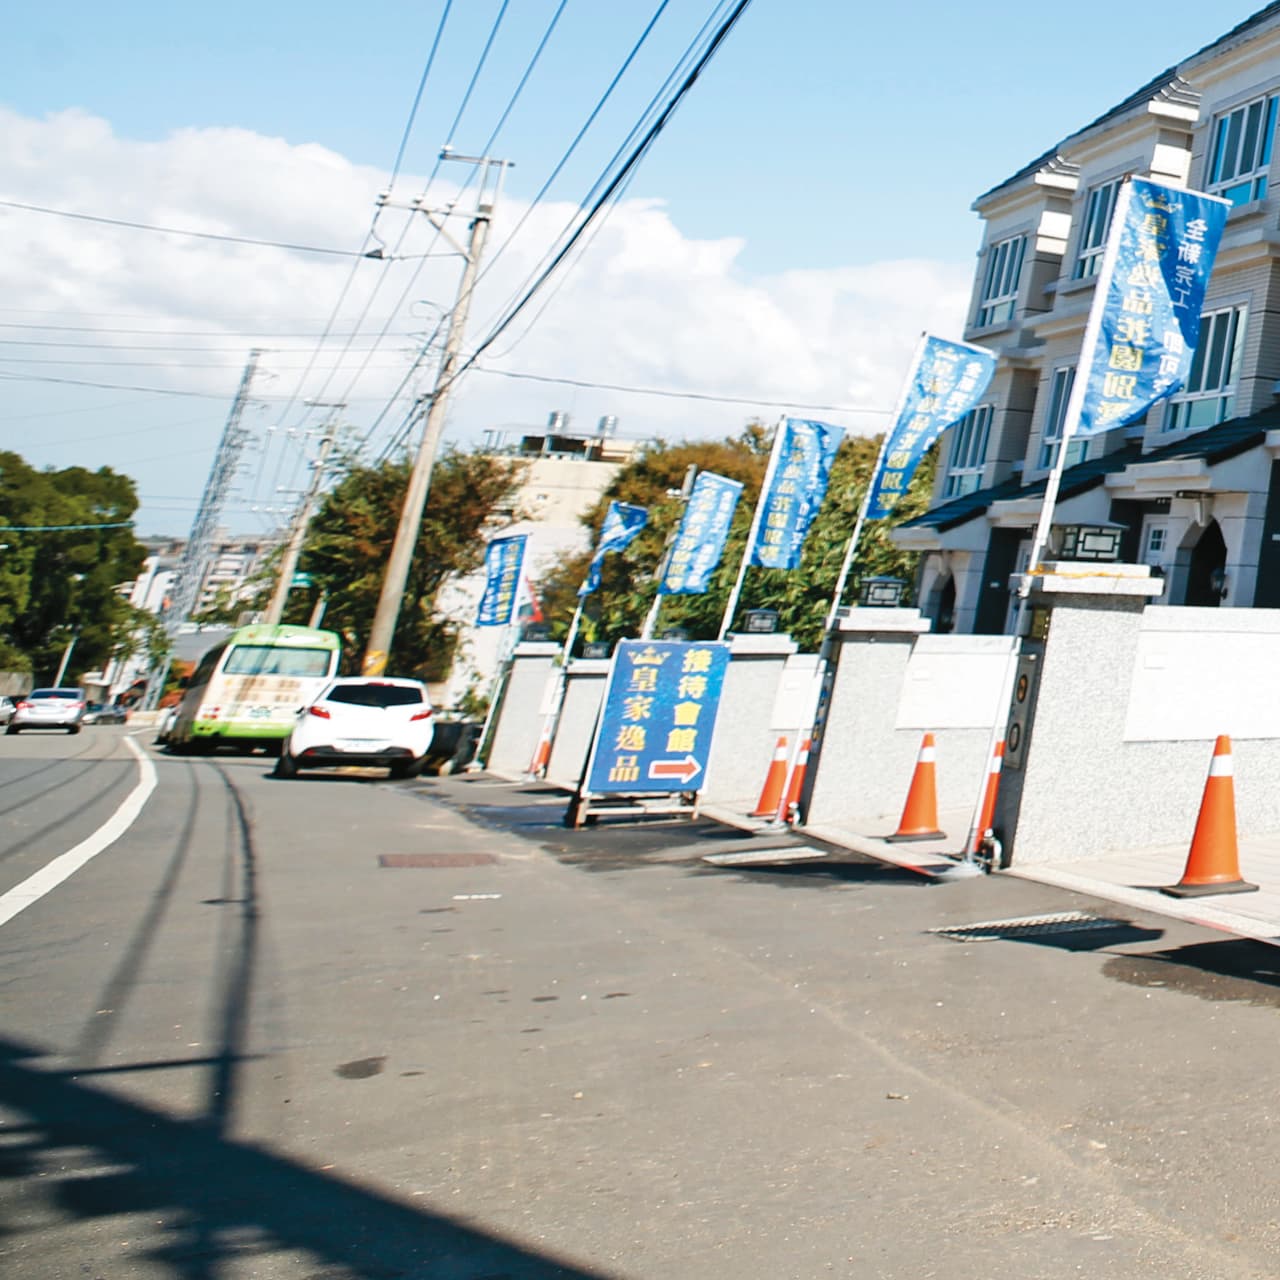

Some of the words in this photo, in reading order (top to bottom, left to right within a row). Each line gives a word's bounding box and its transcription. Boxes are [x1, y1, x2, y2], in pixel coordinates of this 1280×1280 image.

[608, 666, 658, 783] 皇家逸品
[666, 648, 713, 753] 接待會館
